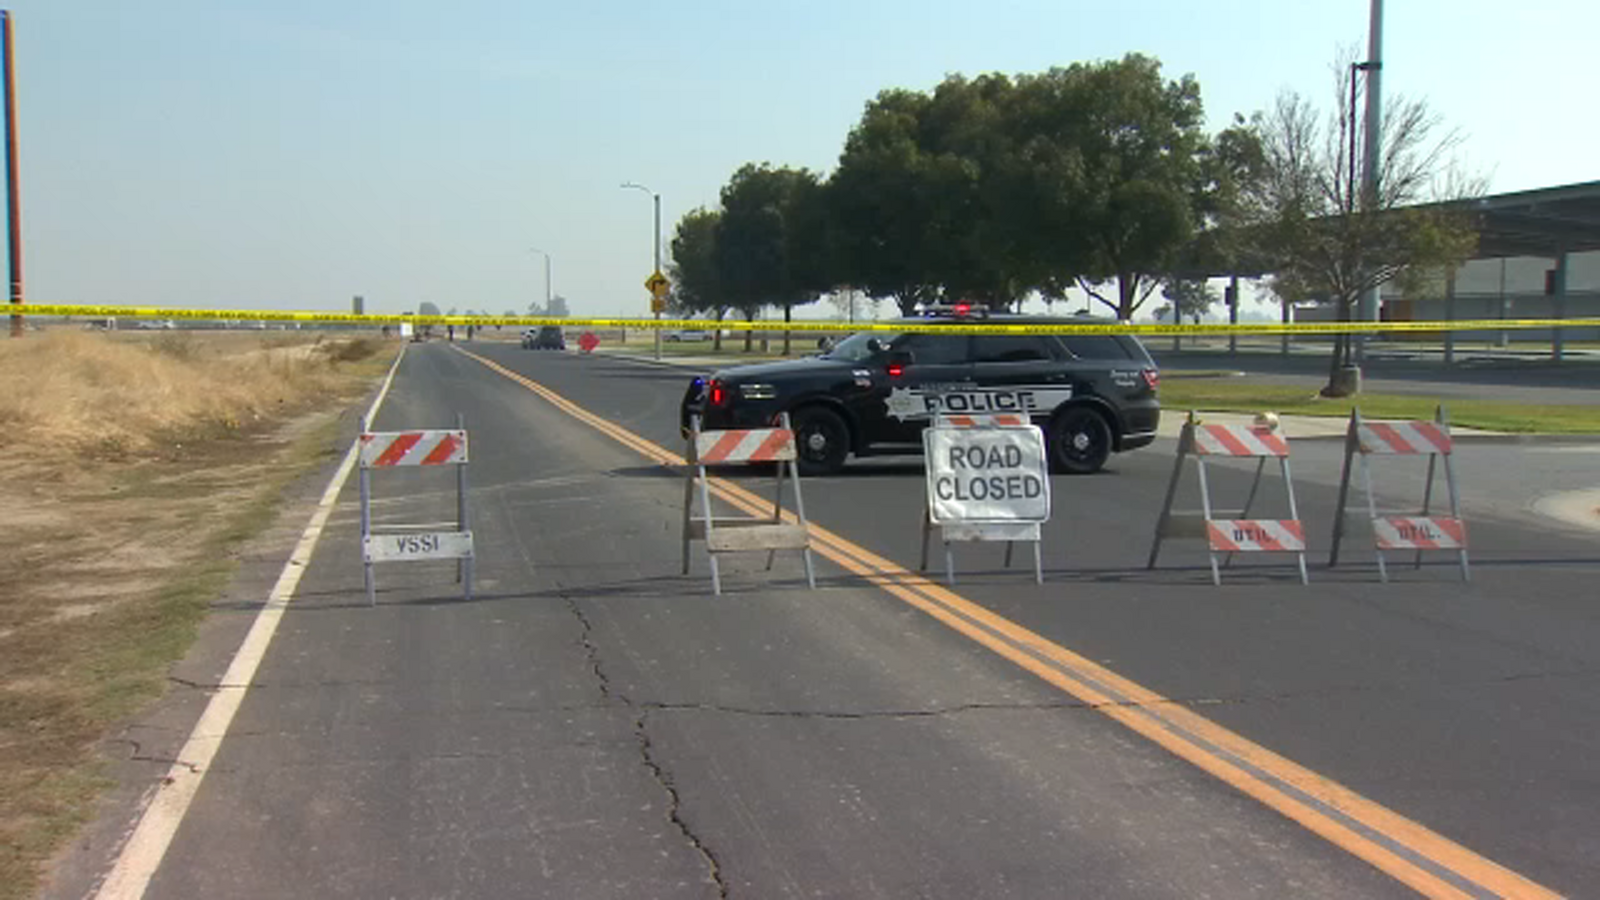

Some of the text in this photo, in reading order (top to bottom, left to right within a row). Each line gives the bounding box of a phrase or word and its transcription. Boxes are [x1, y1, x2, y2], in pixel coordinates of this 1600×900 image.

[924, 392, 1036, 412] POLICE
[949, 444, 1023, 470] ROAD
[936, 475, 1042, 502] CLOSED
